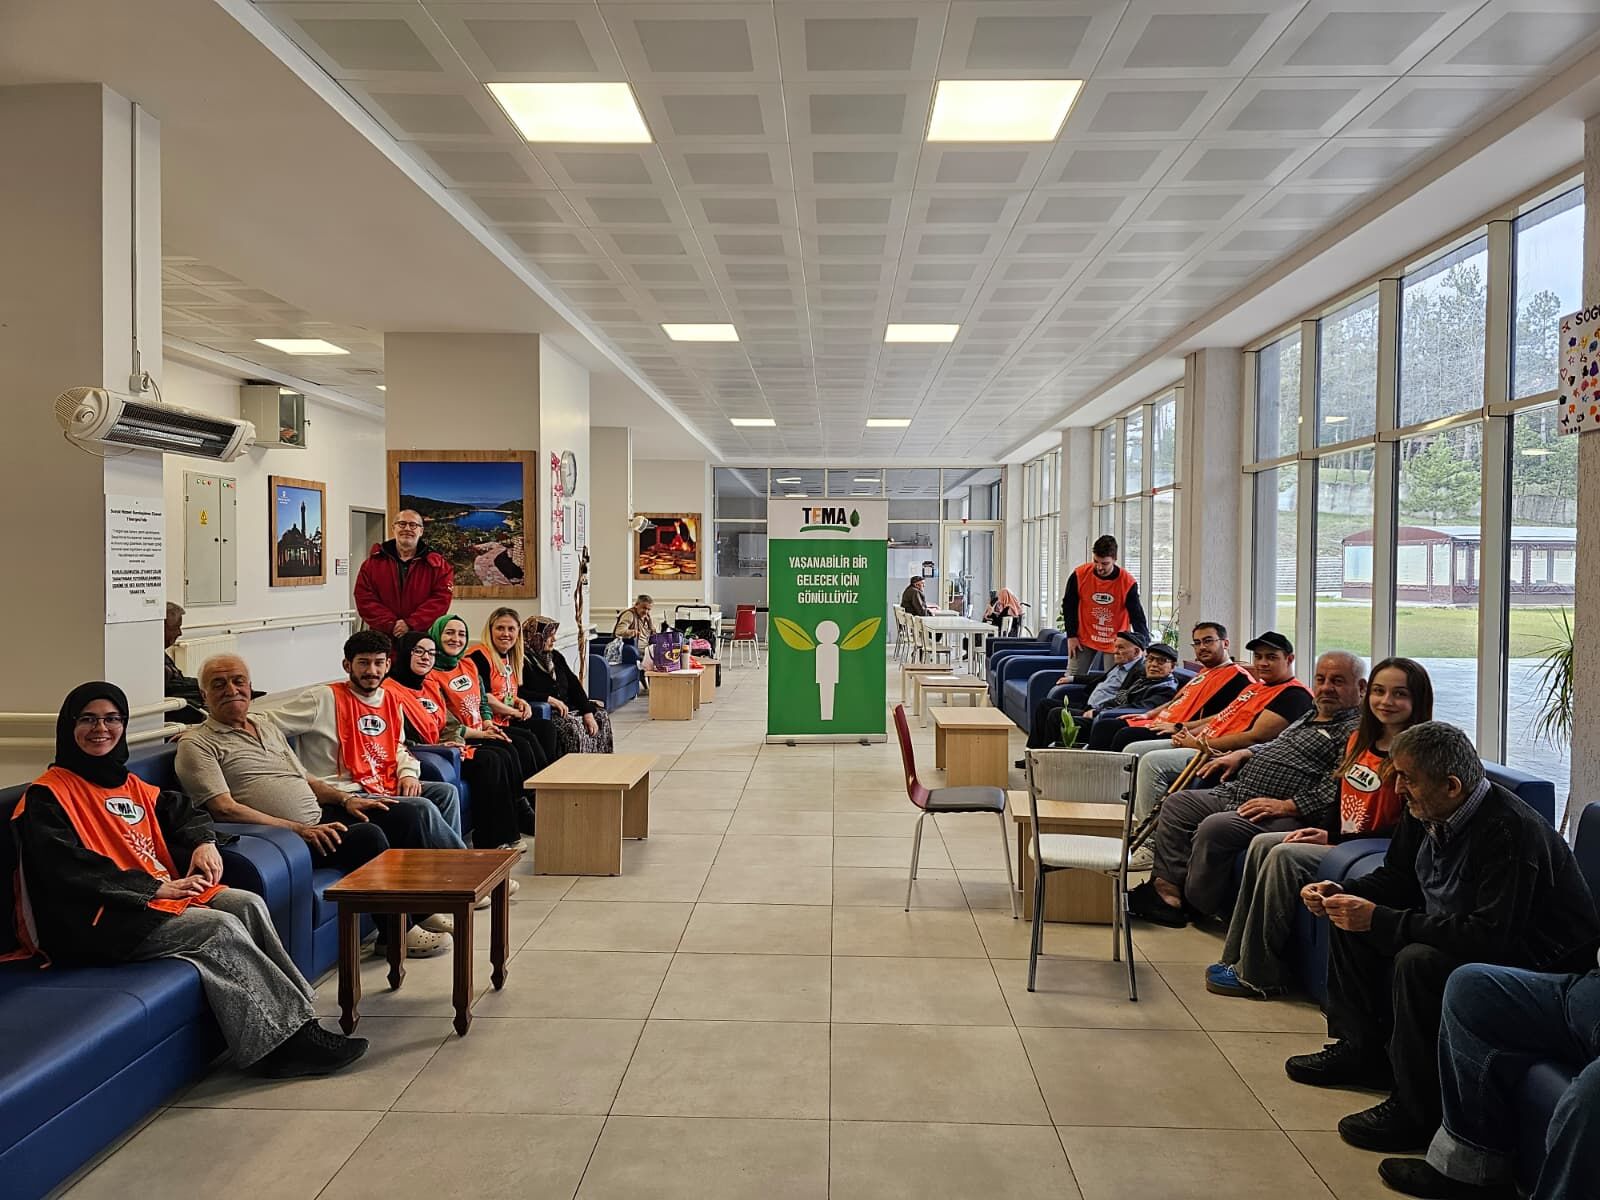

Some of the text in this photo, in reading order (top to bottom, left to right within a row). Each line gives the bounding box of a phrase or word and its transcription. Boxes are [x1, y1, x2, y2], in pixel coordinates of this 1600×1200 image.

[802, 507, 847, 525] TEMA
[789, 554, 868, 569] YAŞANABİLİR BİR
[796, 572, 860, 588] GELECEK İÇİN
[797, 590, 859, 604] GÖNÜLLÜYÜZ
[108, 802, 133, 815] TMA
